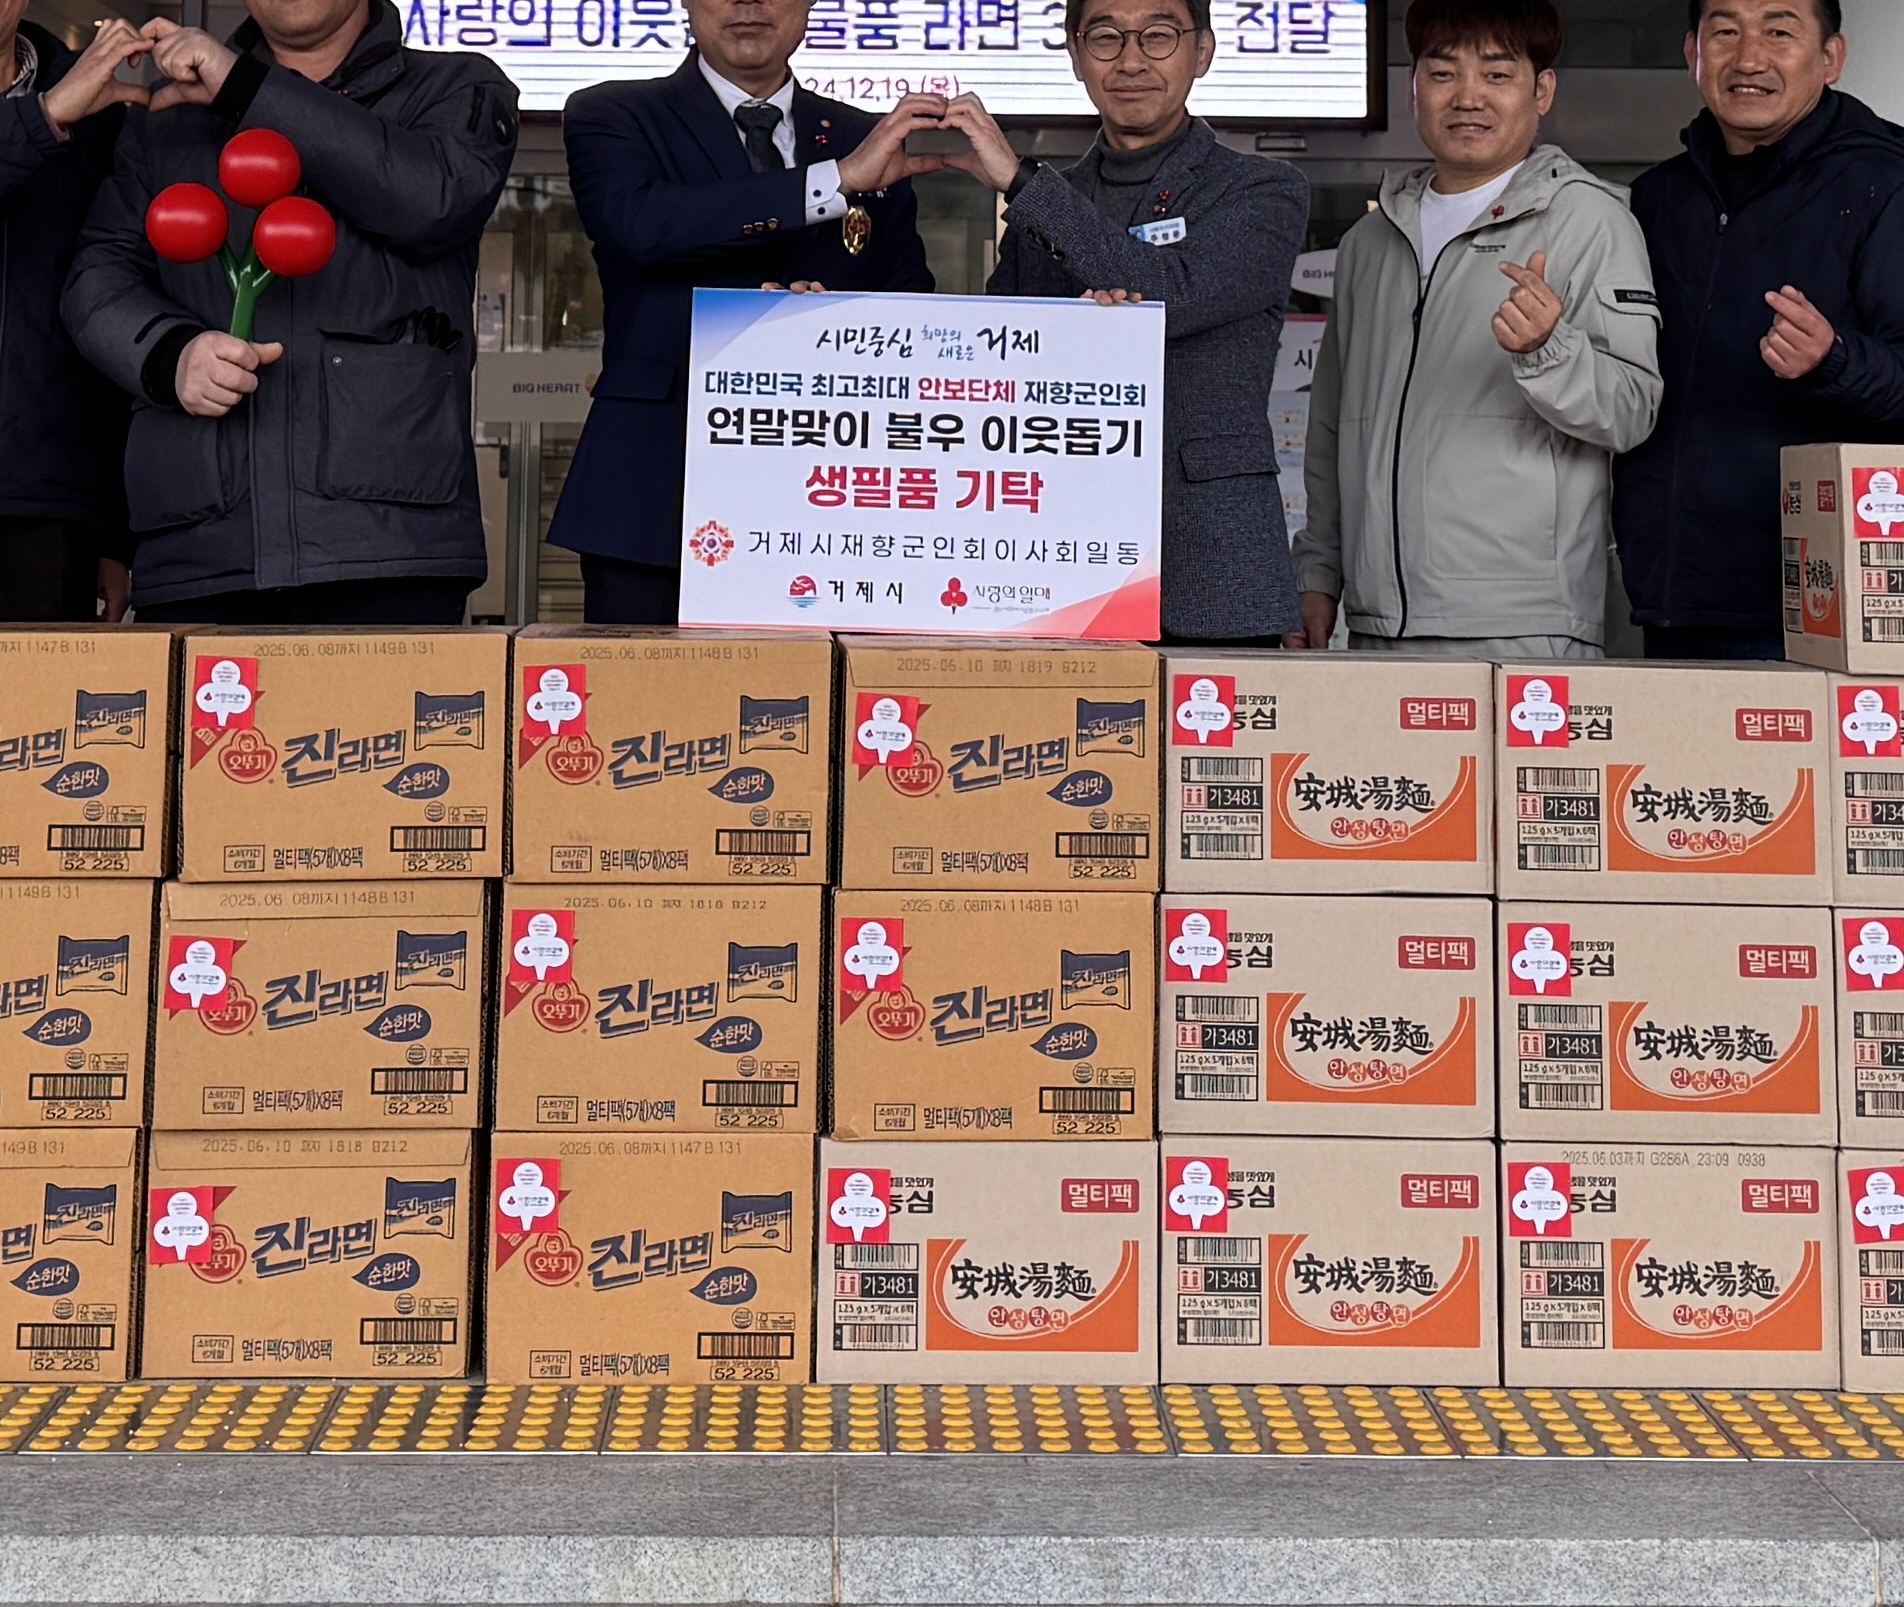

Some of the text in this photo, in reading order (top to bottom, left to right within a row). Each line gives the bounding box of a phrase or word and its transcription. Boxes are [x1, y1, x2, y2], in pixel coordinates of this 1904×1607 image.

[1236, 1, 1336, 54] 전달
[816, 325, 914, 358] 시민중심
[977, 325, 1039, 360] 거제
[938, 345, 975, 361] 새로운
[705, 370, 1147, 408] 대한민국 최고최대 안보단체 재향군인회
[707, 406, 1142, 457] 연말맞이 불우 이웃돕기
[806, 466, 1044, 513] 생필품 기탁
[828, 580, 904, 605] 거제시
[1407, 702, 1469, 726] 멀티팩
[1743, 713, 1806, 738] 멀티팩
[229, 754, 267, 770] 오뚜기
[281, 727, 407, 788] 진라면
[556, 755, 593, 772] 오뚜기
[607, 730, 732, 791] 진라면
[947, 734, 1070, 794] 진라면
[56, 768, 100, 794] 순한맛
[397, 769, 441, 796] 순한맛
[723, 773, 766, 799] 순한맛
[896, 768, 933, 784] 오뚜기
[1061, 777, 1104, 802] 순한맛
[1210, 788, 1259, 807] 가3481
[1546, 799, 1596, 818] 가3481
[1333, 819, 1408, 839] 안성탕면
[1670, 831, 1747, 851] 안성탕면
[1405, 941, 1469, 966] 멀티팩
[1747, 949, 1812, 975] 멀티팩
[261, 968, 389, 1030] 진라면
[594, 978, 720, 1040] 진라면
[379, 1011, 423, 1037] 순한맛
[542, 1004, 580, 1020] 오뚜기
[878, 1011, 915, 1028] 오뚜기
[929, 985, 1054, 1047] 진라면
[38, 1015, 82, 1042] 순한맛
[710, 1023, 754, 1049] 순한맛
[1204, 1028, 1255, 1047] 가3481
[1045, 1029, 1088, 1056] 순한맛
[1548, 1037, 1598, 1056] 가3481
[1329, 1060, 1406, 1081] 안성탕면
[1673, 1069, 1750, 1090] 안성탕면
[46, 1107, 106, 1120] 52 225
[1068, 1183, 1133, 1209] 멀티팩
[1408, 1179, 1472, 1205] 멀티팩
[1748, 1183, 1812, 1209] 멀티팩
[251, 1216, 378, 1278] 진라면
[535, 1256, 572, 1273] 오뚜기
[587, 1228, 714, 1292] 진라면
[26, 1265, 70, 1292] 순한맛
[367, 1260, 412, 1286] 순한맛
[863, 1275, 914, 1296] 가3481
[1206, 1270, 1257, 1290] 가3481
[1550, 1274, 1600, 1294] 가3481
[704, 1274, 748, 1301] 순한맛
[990, 1307, 1068, 1329] 안성탕면
[1333, 1302, 1410, 1324] 안성탕면
[1676, 1306, 1753, 1327] 안성탕면
